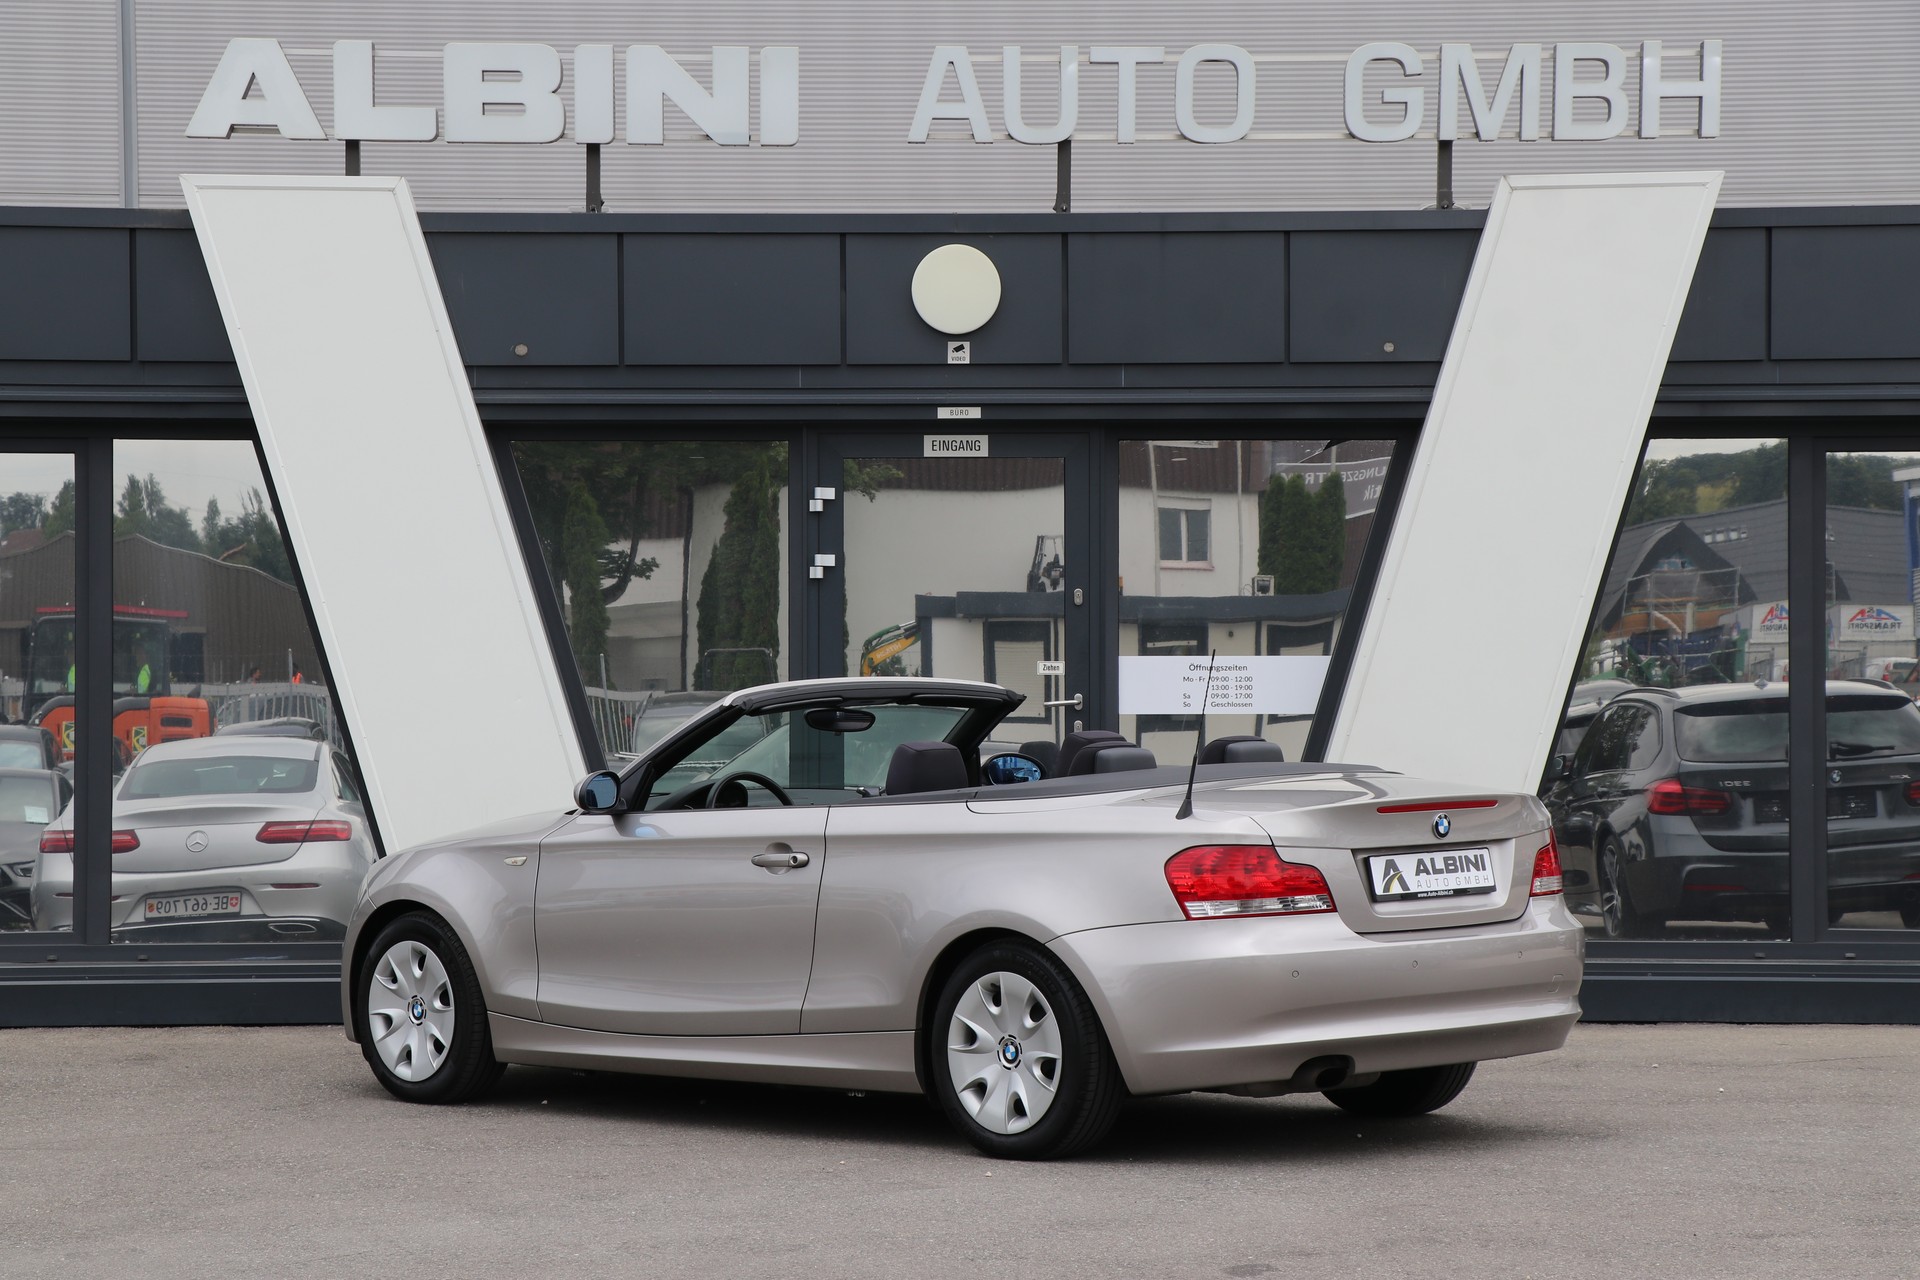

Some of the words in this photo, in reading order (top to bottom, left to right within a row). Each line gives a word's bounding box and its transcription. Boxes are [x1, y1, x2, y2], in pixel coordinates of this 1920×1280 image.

[185, 37, 799, 147] ALBINI
[907, 43, 1257, 146] AUTO
[1343, 39, 1723, 144] GMBH
[931, 440, 981, 452] EINGANG
[1188, 663, 1248, 672] Öffnungszeiten
[1414, 853, 1487, 876] ALBINI
[1416, 877, 1450, 889] AUTO
[1455, 875, 1490, 887] GMBH
